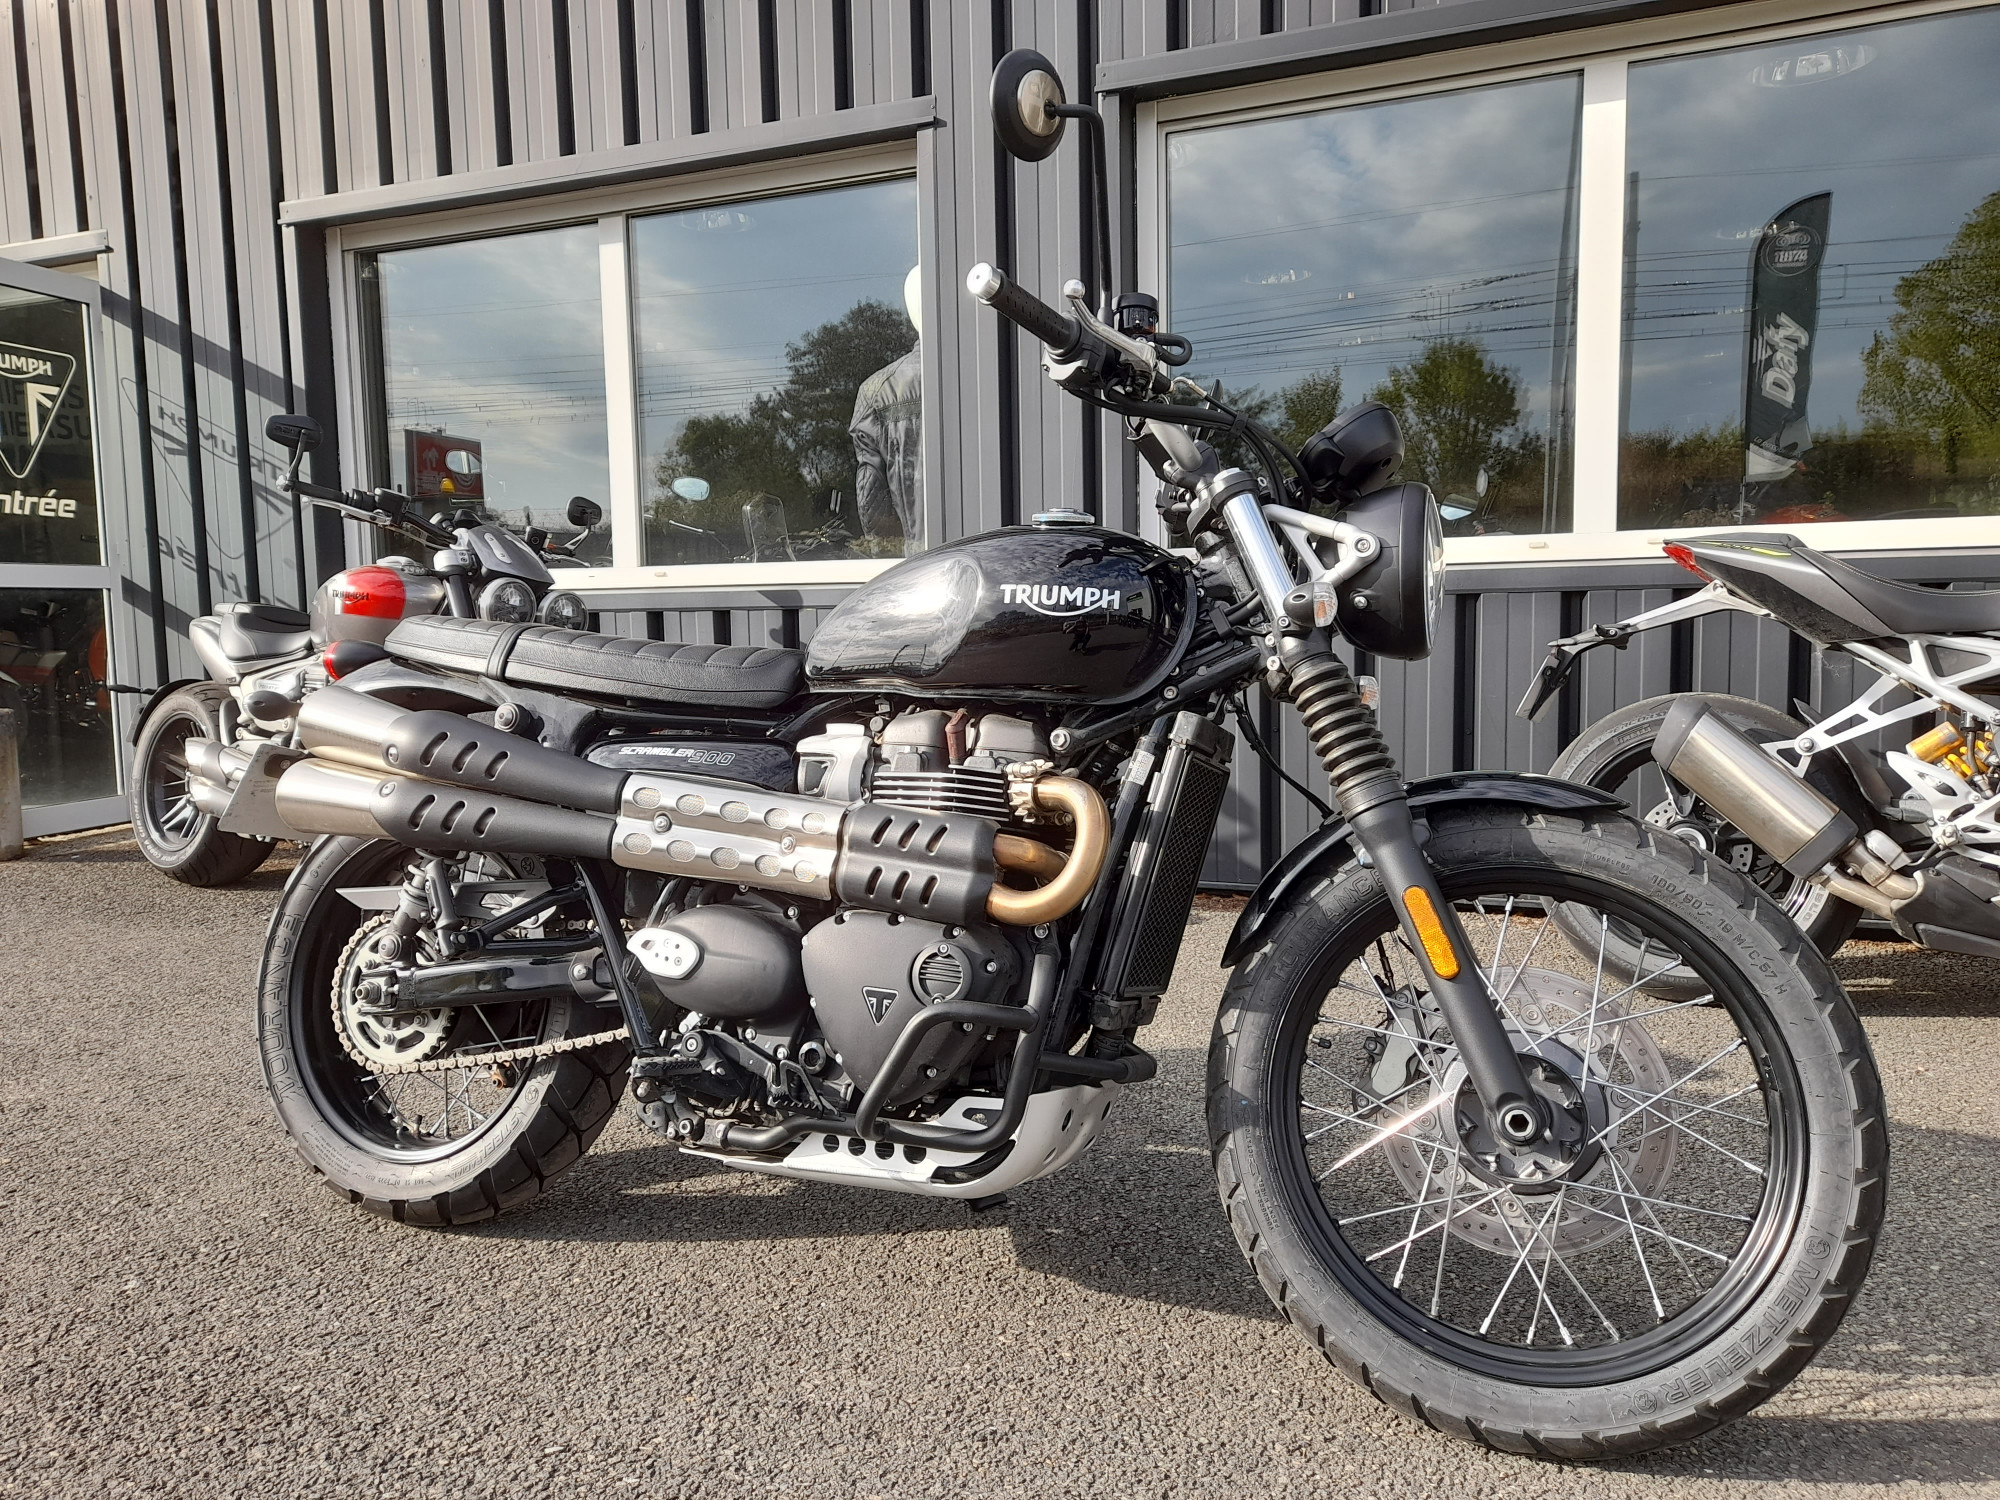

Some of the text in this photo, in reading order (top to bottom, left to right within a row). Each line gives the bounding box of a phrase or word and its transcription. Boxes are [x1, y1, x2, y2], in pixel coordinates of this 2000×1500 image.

[332, 590, 369, 604] TRIUMPH
[999, 583, 1121, 617] TRIUMPH
[618, 746, 694, 758] SCRAMBLER
[261, 912, 299, 1106] TOURANCE
[1660, 1261, 1821, 1404] METZELER
